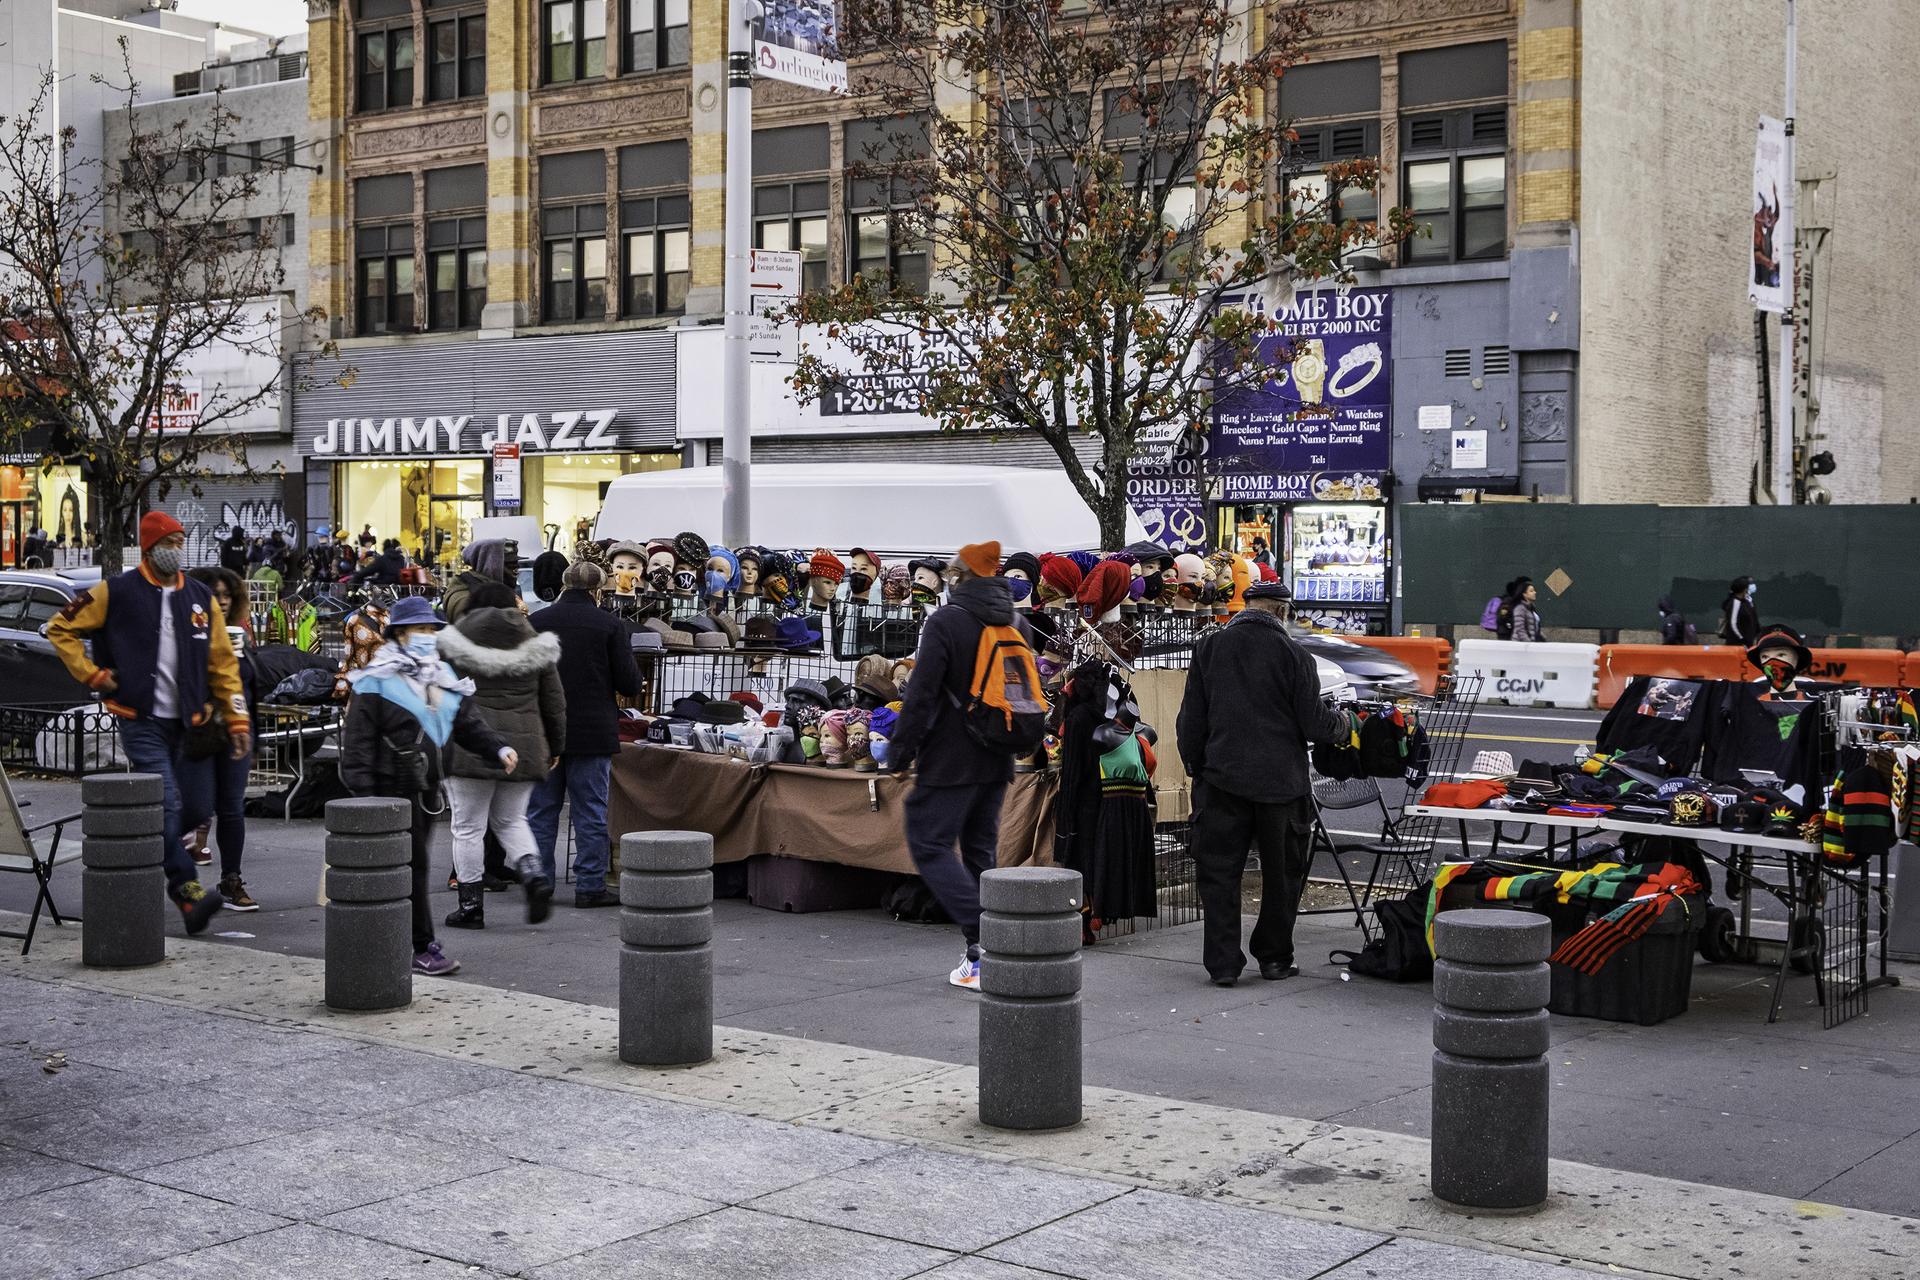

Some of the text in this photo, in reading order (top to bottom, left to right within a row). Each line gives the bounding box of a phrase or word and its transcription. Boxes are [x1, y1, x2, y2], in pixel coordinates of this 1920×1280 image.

[760, 46, 844, 84] Burlington
[1335, 293, 1389, 320] BOY
[1322, 320, 1352, 335] 2000
[1355, 319, 1381, 333] INC
[759, 332, 782, 340] Sunday
[885, 375, 922, 389] TROY
[1220, 413, 1240, 424] Ring
[1345, 409, 1384, 420] Watches
[313, 409, 621, 454] JIMMY JAZZ
[1222, 420, 1381, 435] Bracelets Gold Caps Name Ring
[1238, 433, 1364, 446] Name Plate Name Earring
[1149, 444, 1169, 454] Mora
[1310, 455, 1326, 464] Tel:
[1225, 474, 1311, 491] HOME BOY
[1229, 490, 1306, 500] JEWELRY 2000 INC
[1807, 662, 1847, 678] CJV
[1496, 678, 1545, 694] CCJV
